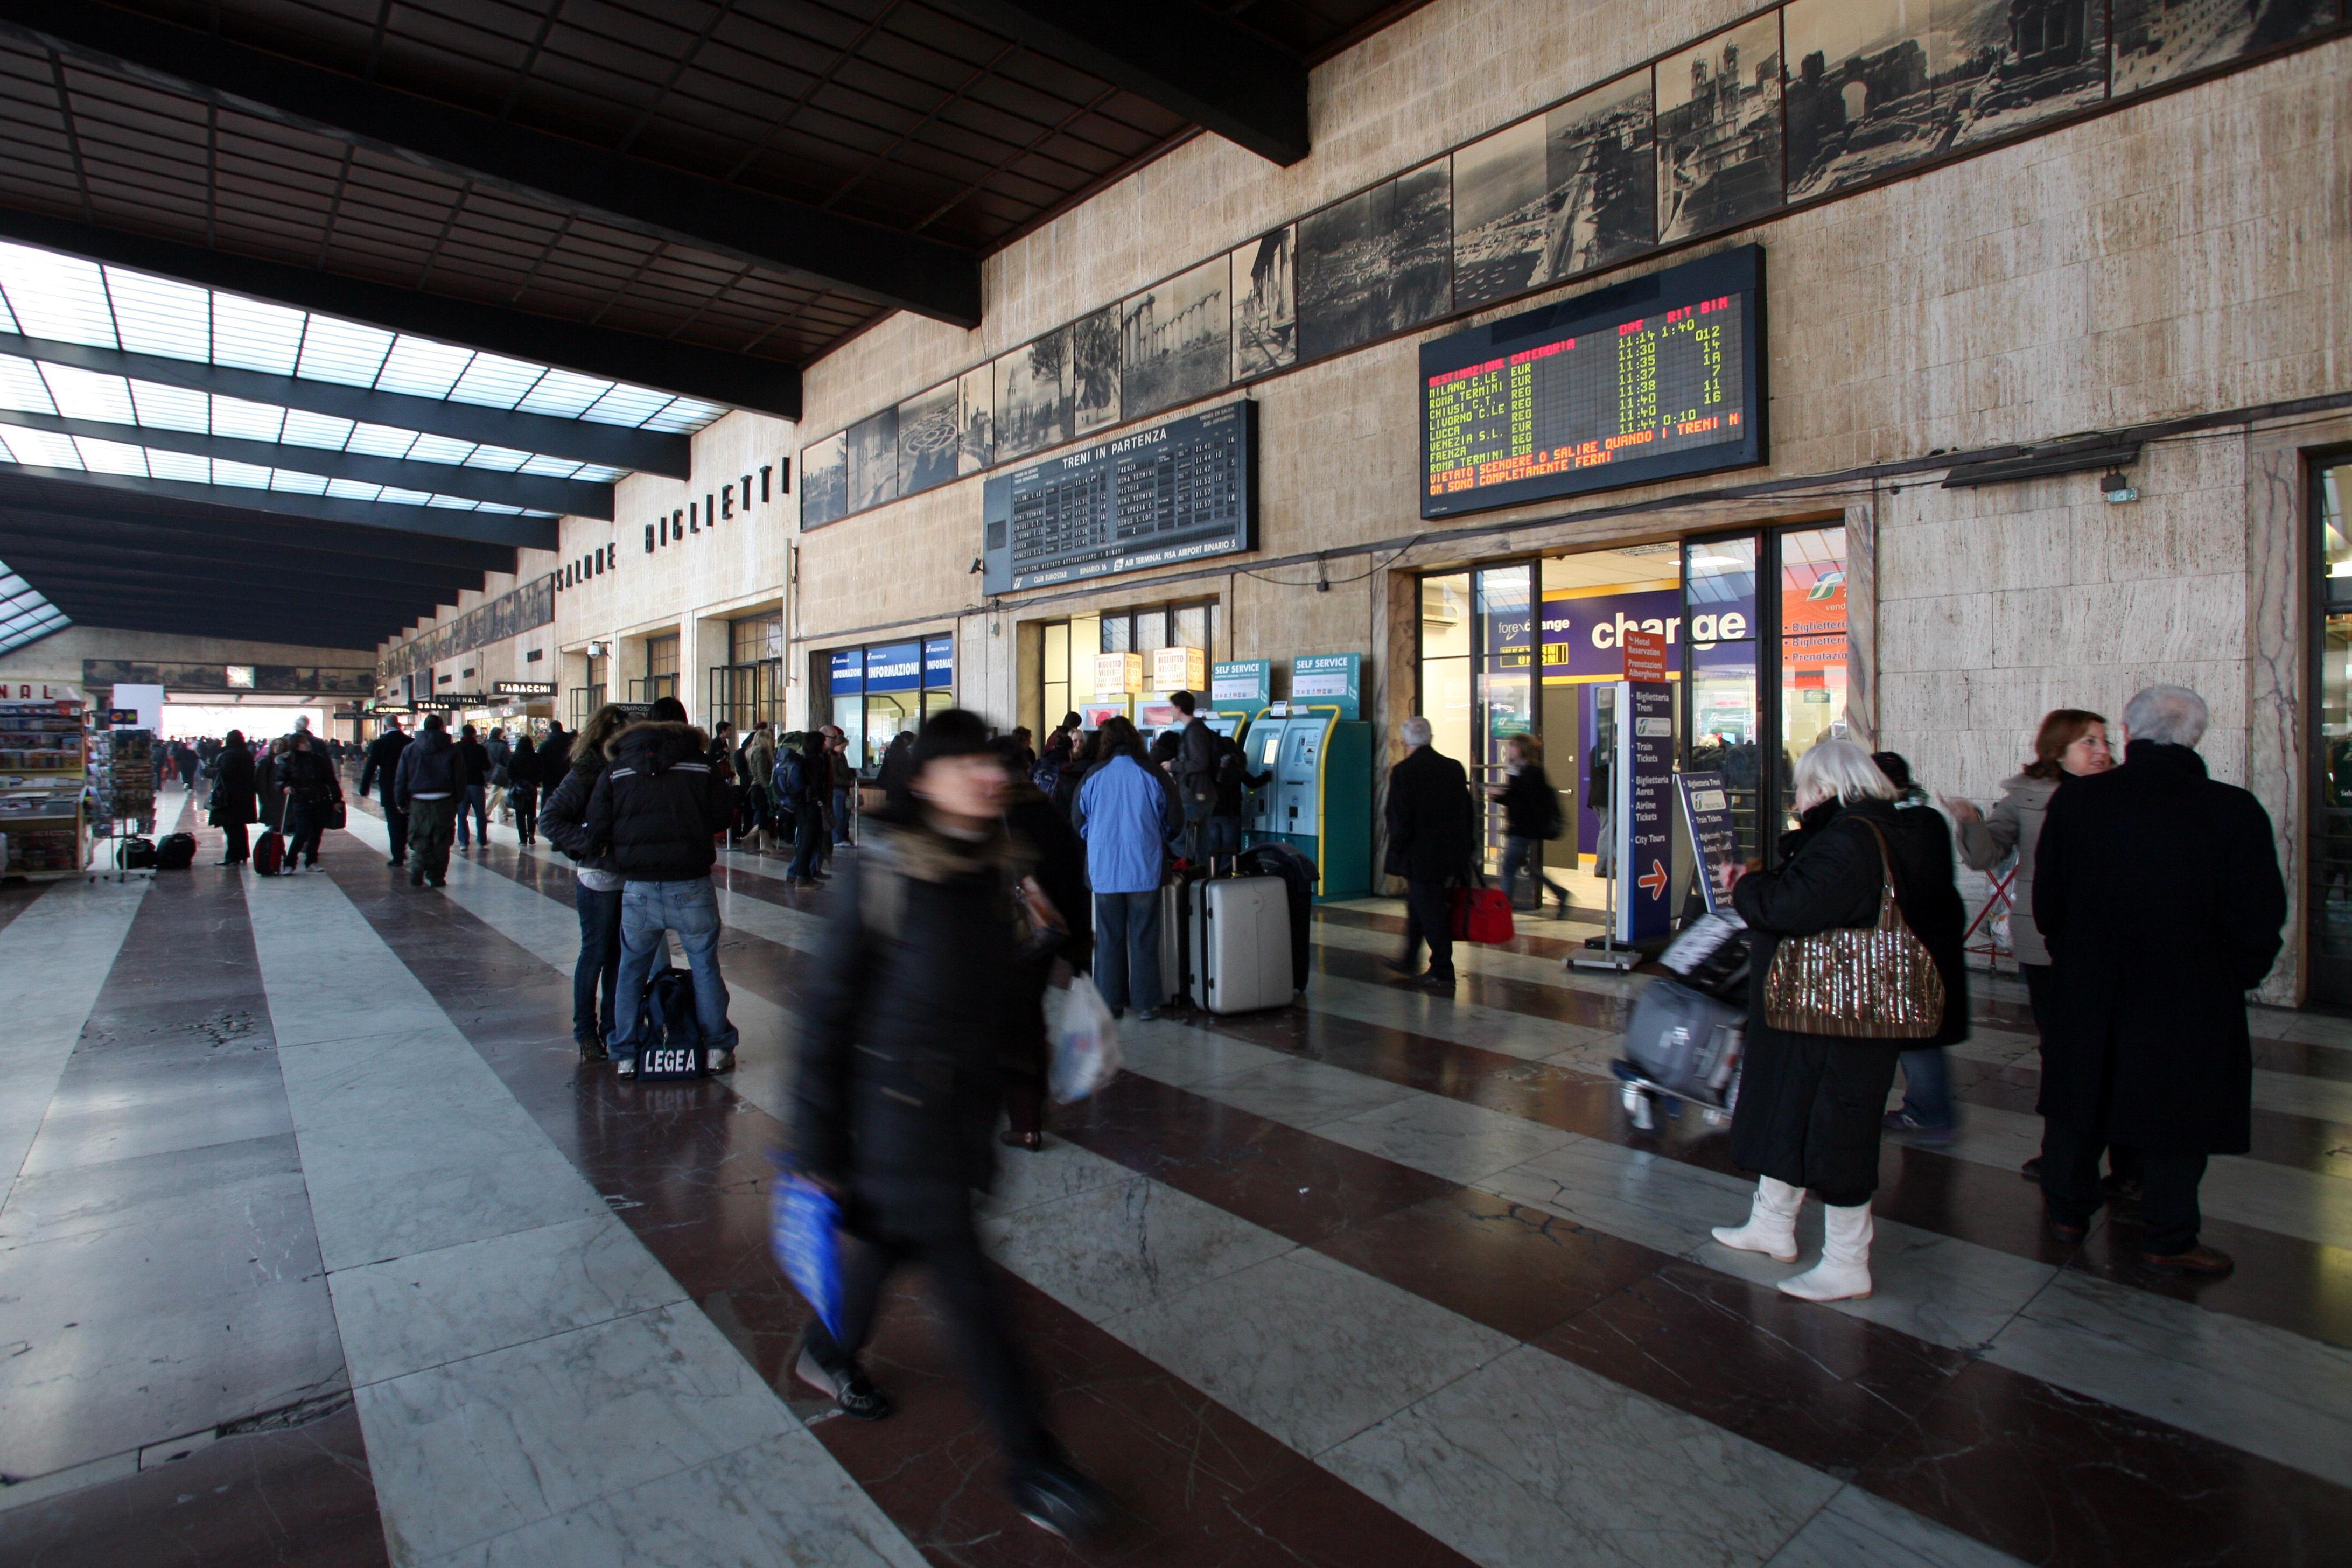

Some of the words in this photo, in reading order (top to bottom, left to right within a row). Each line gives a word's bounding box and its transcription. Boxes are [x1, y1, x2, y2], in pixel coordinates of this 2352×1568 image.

[1429, 358, 1505, 388] DESTINAZIONE
[1510, 338, 1576, 365] CATEGORIA
[1619, 319, 1643, 336] ORE
[1667, 305, 1692, 323] RIT
[1700, 296, 1728, 314] BIN
[1429, 380, 1466, 398] MILANO
[1472, 372, 1498, 387] C.LE
[1511, 362, 1531, 377] EUR
[1619, 330, 1655, 349] 11:14
[1662, 319, 1695, 338] 1:40
[1429, 395, 1453, 409] ROMA
[1460, 381, 1503, 401] TERMINI
[1511, 374, 1531, 388] EUR
[1619, 342, 1655, 361] 11:30
[1429, 403, 1464, 419] CHIUSI
[1473, 396, 1496, 409] C.T.
[1511, 386, 1531, 399] REG
[1619, 355, 1656, 373] 11:35
[1703, 339, 1720, 353] 14
[1430, 412, 1472, 431] LIVORNO
[1479, 403, 1505, 419] C.LE
[1511, 397, 1531, 411] REG
[1619, 367, 1656, 386] 11:37
[1704, 352, 1720, 366] 1A
[1430, 426, 1460, 441] LUCCA
[1511, 409, 1532, 422] REG
[1619, 380, 1656, 398] 11:38
[1713, 364, 1720, 376] 7
[1430, 433, 1473, 451] VENEZIA
[1479, 428, 1503, 442] S.L.
[1511, 420, 1532, 434] EUR
[1619, 392, 1656, 410] 11:40
[1704, 378, 1720, 392] 11
[1430, 446, 1467, 463] FAENZA
[1511, 431, 1532, 445] REG
[1620, 405, 1656, 423] 11:40
[1704, 391, 1721, 405] 16
[1430, 460, 1454, 474] ROMA
[1460, 449, 1503, 467] TERMINI
[1512, 443, 1532, 457] EUR
[1620, 418, 1656, 435] 11:44
[1663, 409, 1696, 425] 0:10
[1062, 451, 1090, 470] TRENI
[1096, 446, 1106, 460] IN
[1111, 428, 1167, 455] PARTENZA
[1430, 465, 1473, 484] VIETATO
[1479, 453, 1534, 475] SCENDERE
[1539, 450, 1548, 462] O
[1554, 440, 1599, 460] SALIRE
[1605, 429, 1654, 450] QUANDO
[1662, 427, 1668, 439] I
[1677, 416, 1719, 436] TRENI
[1728, 412, 1740, 426] N
[1118, 464, 1136, 474] FAENZA
[1133, 470, 1154, 480] TERMINI
[1430, 484, 1443, 496] ON
[1448, 478, 1474, 492] SONO
[1479, 459, 1569, 486] COMPLETAMENTE
[1575, 450, 1613, 468] FERMI
[1118, 484, 1139, 495] PISTOIA
[1196, 465, 1210, 475] 11.47
[1127, 504, 1145, 514] SPEZIA
[1196, 488, 1210, 498] 11.57
[1133, 491, 1154, 501] TERMINI
[1196, 500, 1210, 509] 11.57
[556, 542, 616, 591] SALONE
[646, 457, 790, 553] BIGLIETTI
[1034, 575, 1044, 583] CLUB
[1045, 571, 1067, 581] EUROSTAR
[1080, 565, 1100, 575] BINARIO
[1125, 559, 1133, 567] AIR
[1136, 553, 1161, 564] TERMINAL
[1164, 551, 1177, 559] PISA
[1178, 545, 1202, 557] AIRPORT
[1204, 540, 1229, 552] BINARIO
[1231, 539, 1236, 547] 5
[1634, 637, 1650, 646] Hotel
[1628, 646, 1660, 656] Reservation
[1099, 660, 1121, 669] BIGLIETTO
[1159, 655, 1183, 664] BIGLIETTO
[1296, 660, 1313, 669] SELF
[1315, 657, 1348, 668] SERVICE
[1628, 659, 1662, 669] Prenotazioni
[868, 662, 919, 679] INFORMAZIONI
[1215, 666, 1230, 674] SELF
[1231, 663, 1259, 673] SERVICE
[1628, 669, 1660, 680] Alberghiere
[500, 684, 551, 693] TABACCHI
[1636, 691, 1669, 703] Biglietteria
[1636, 703, 1653, 712] Treni
[1636, 743, 1653, 751] Train
[1636, 754, 1658, 762] Tickets
[1636, 776, 1669, 787] Biglietteria
[1636, 801, 1656, 810] Airline
[1636, 813, 1657, 822] Tickets
[1635, 835, 1648, 845] City
[1649, 834, 1665, 843] Tours
[645, 1049, 696, 1073] LEGEA
